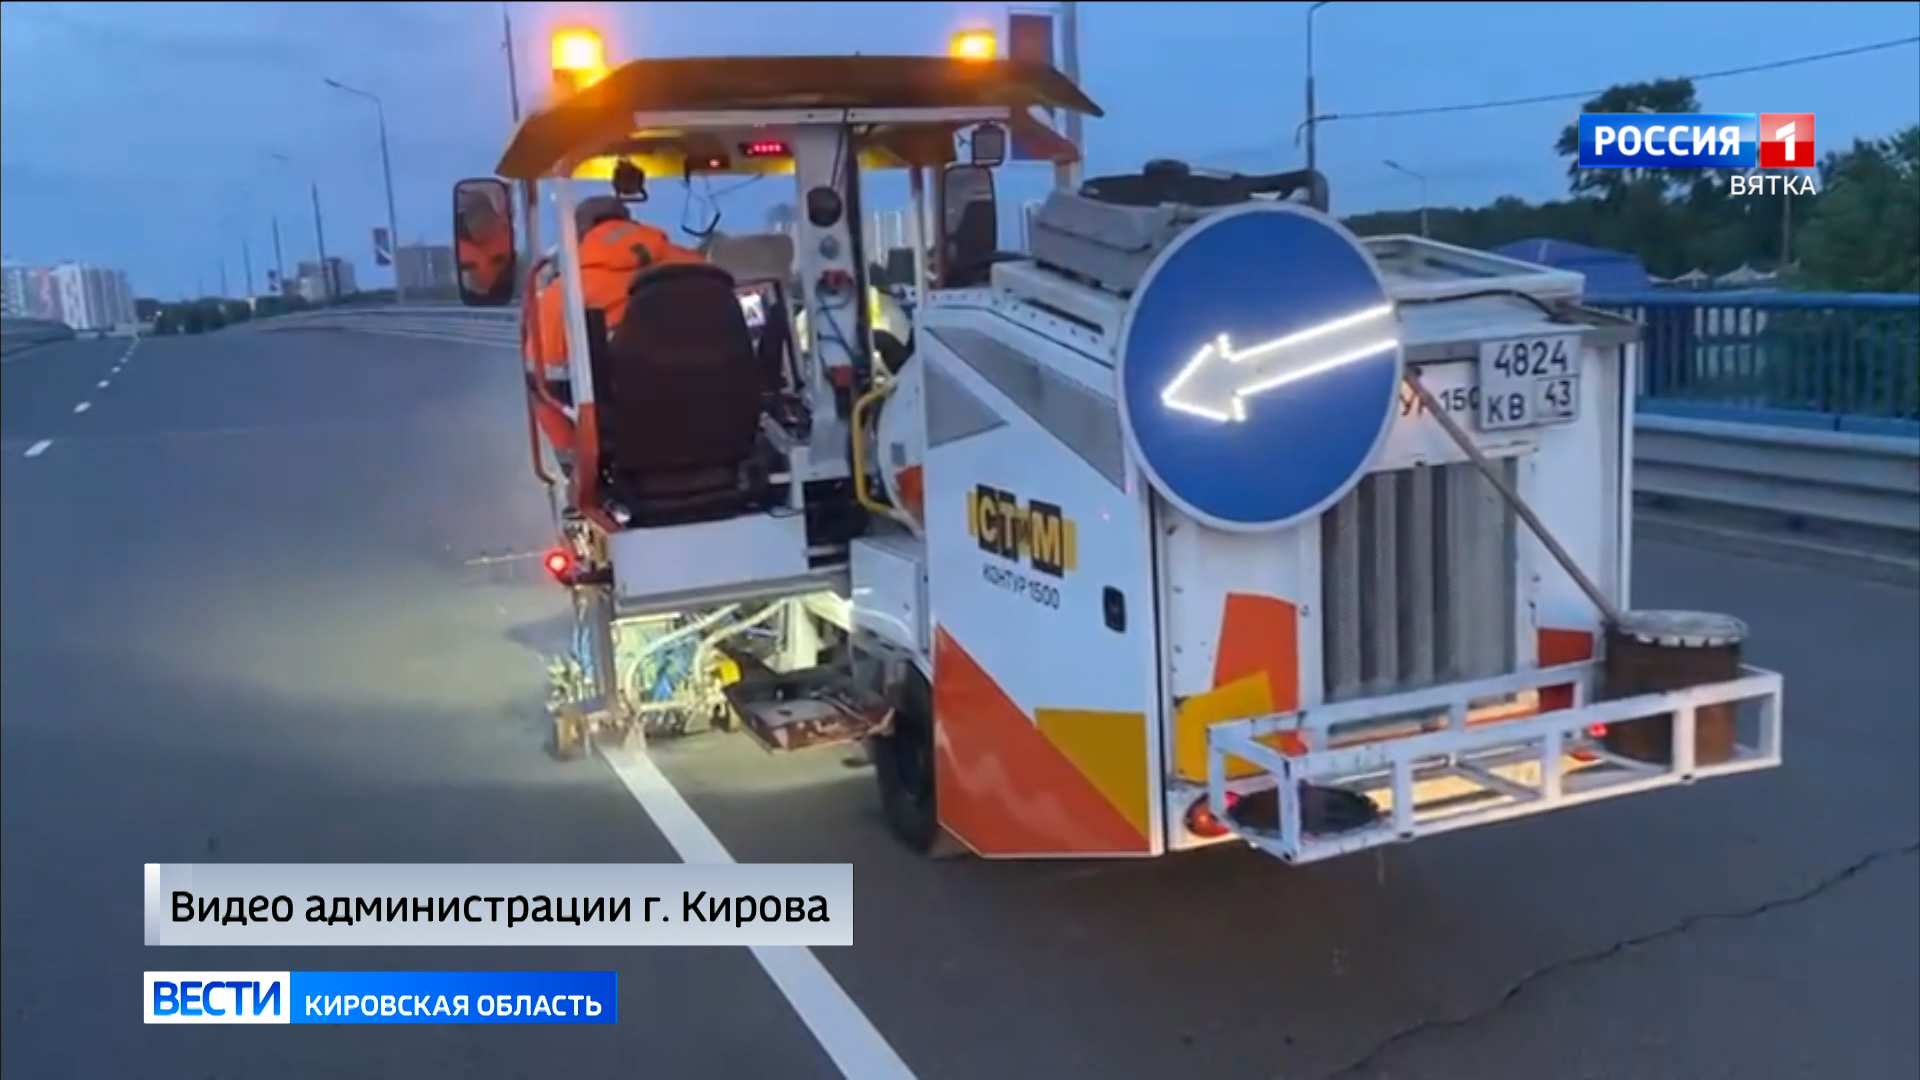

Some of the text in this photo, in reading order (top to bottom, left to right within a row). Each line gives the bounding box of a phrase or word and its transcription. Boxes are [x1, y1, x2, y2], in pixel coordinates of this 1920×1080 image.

[1494, 341, 1568, 378] 4824
[1487, 381, 1572, 423] КВ 43
[1028, 580, 1060, 610] 1500
